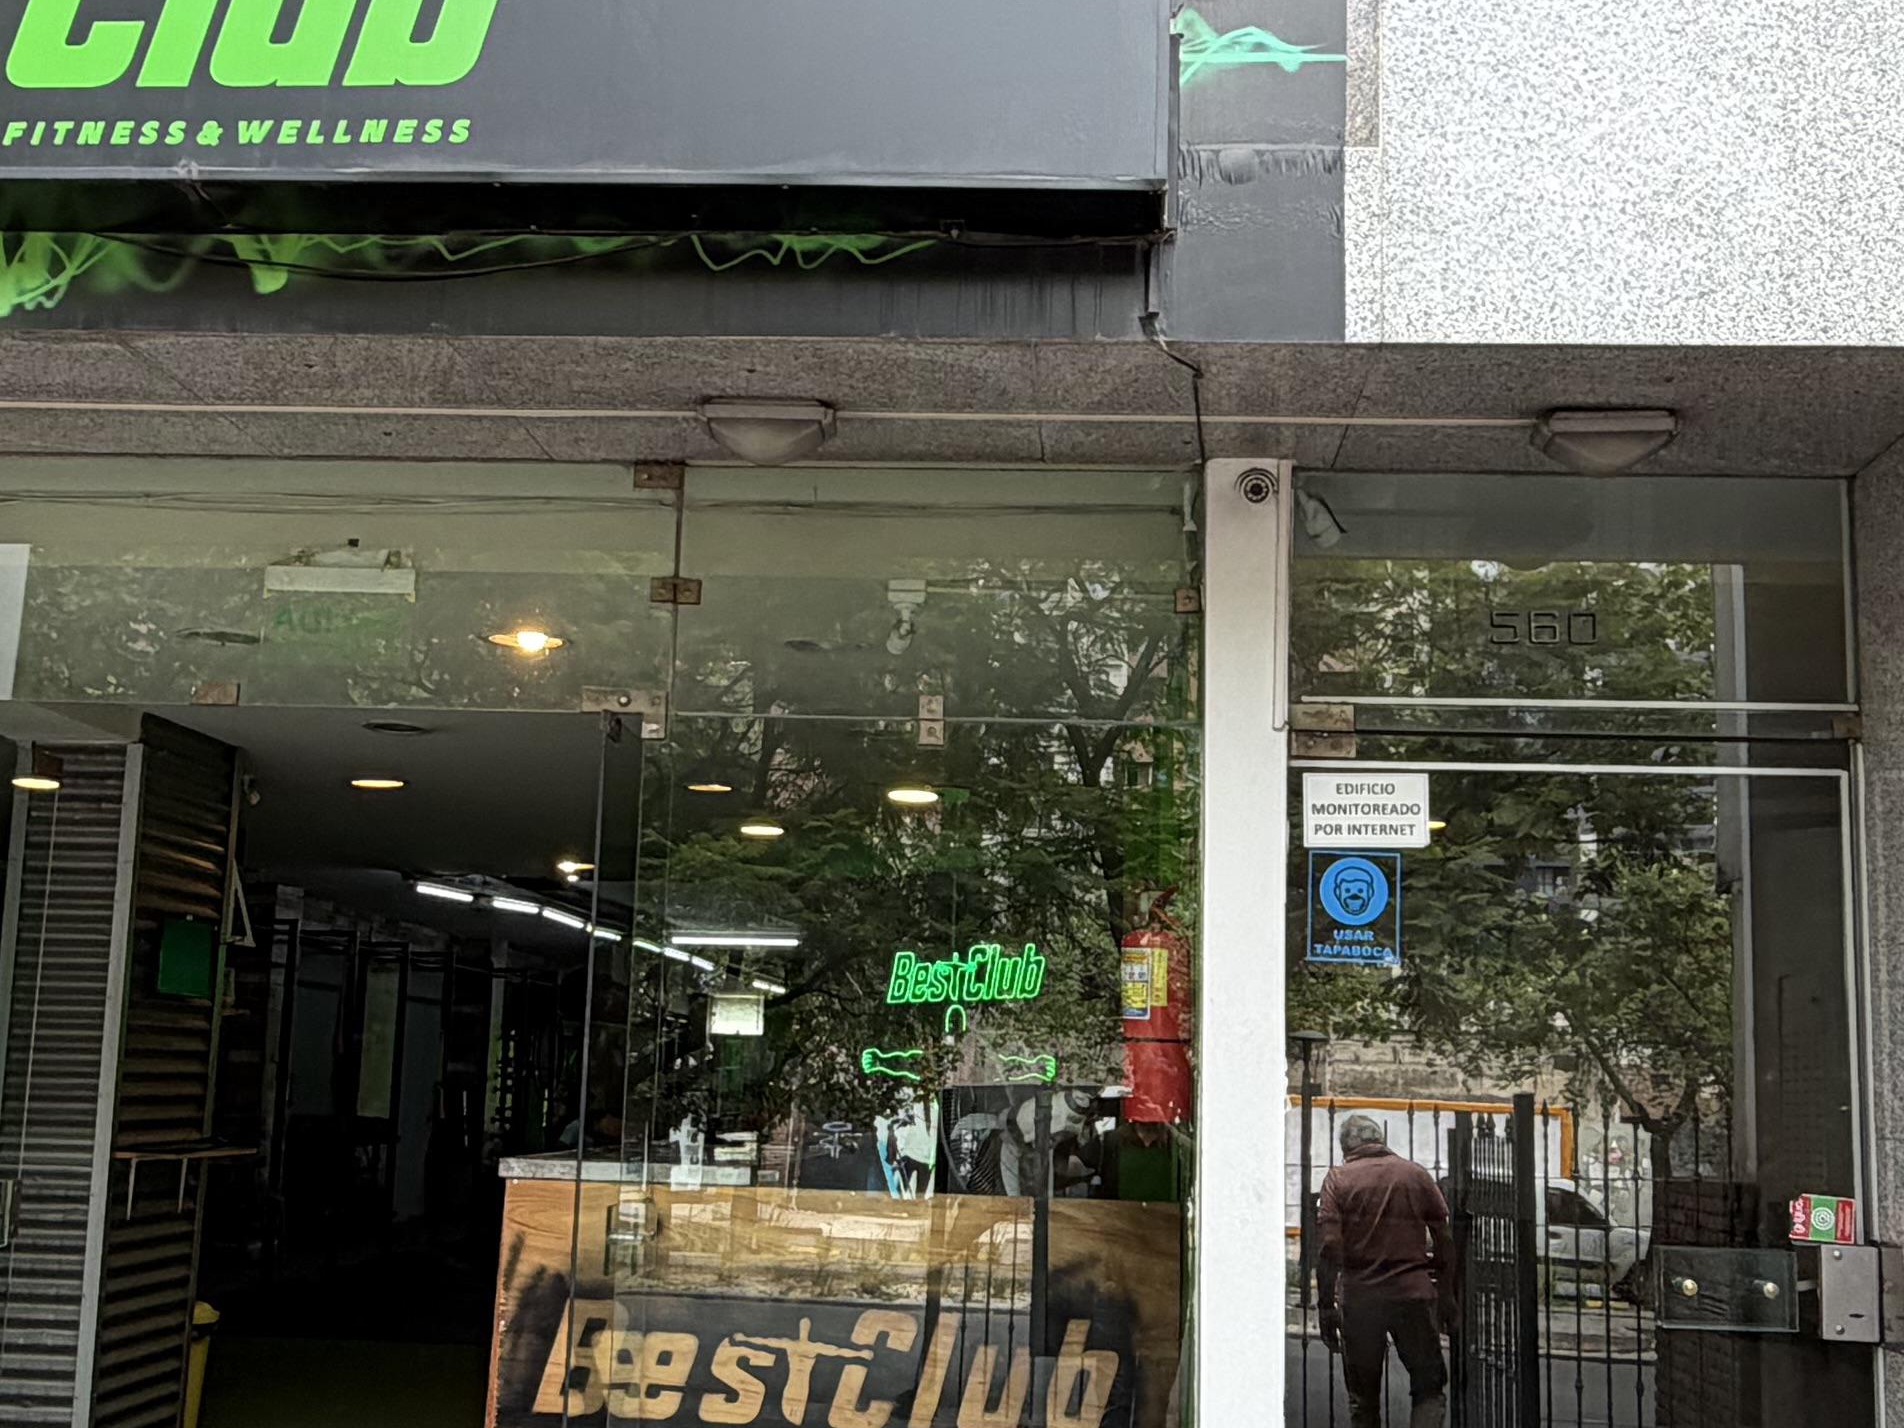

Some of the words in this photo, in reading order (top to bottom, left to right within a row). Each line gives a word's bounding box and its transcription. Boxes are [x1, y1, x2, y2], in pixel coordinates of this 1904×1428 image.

[1490, 610, 1598, 645] 560
[1335, 782, 1396, 795] EDIFICIO
[1311, 803, 1422, 816] MONITOREADO
[1314, 824, 1344, 836] POR
[1347, 824, 1416, 836] INTERNET
[1332, 929, 1375, 941] USAR
[1313, 943, 1394, 958] TAPABOCA
